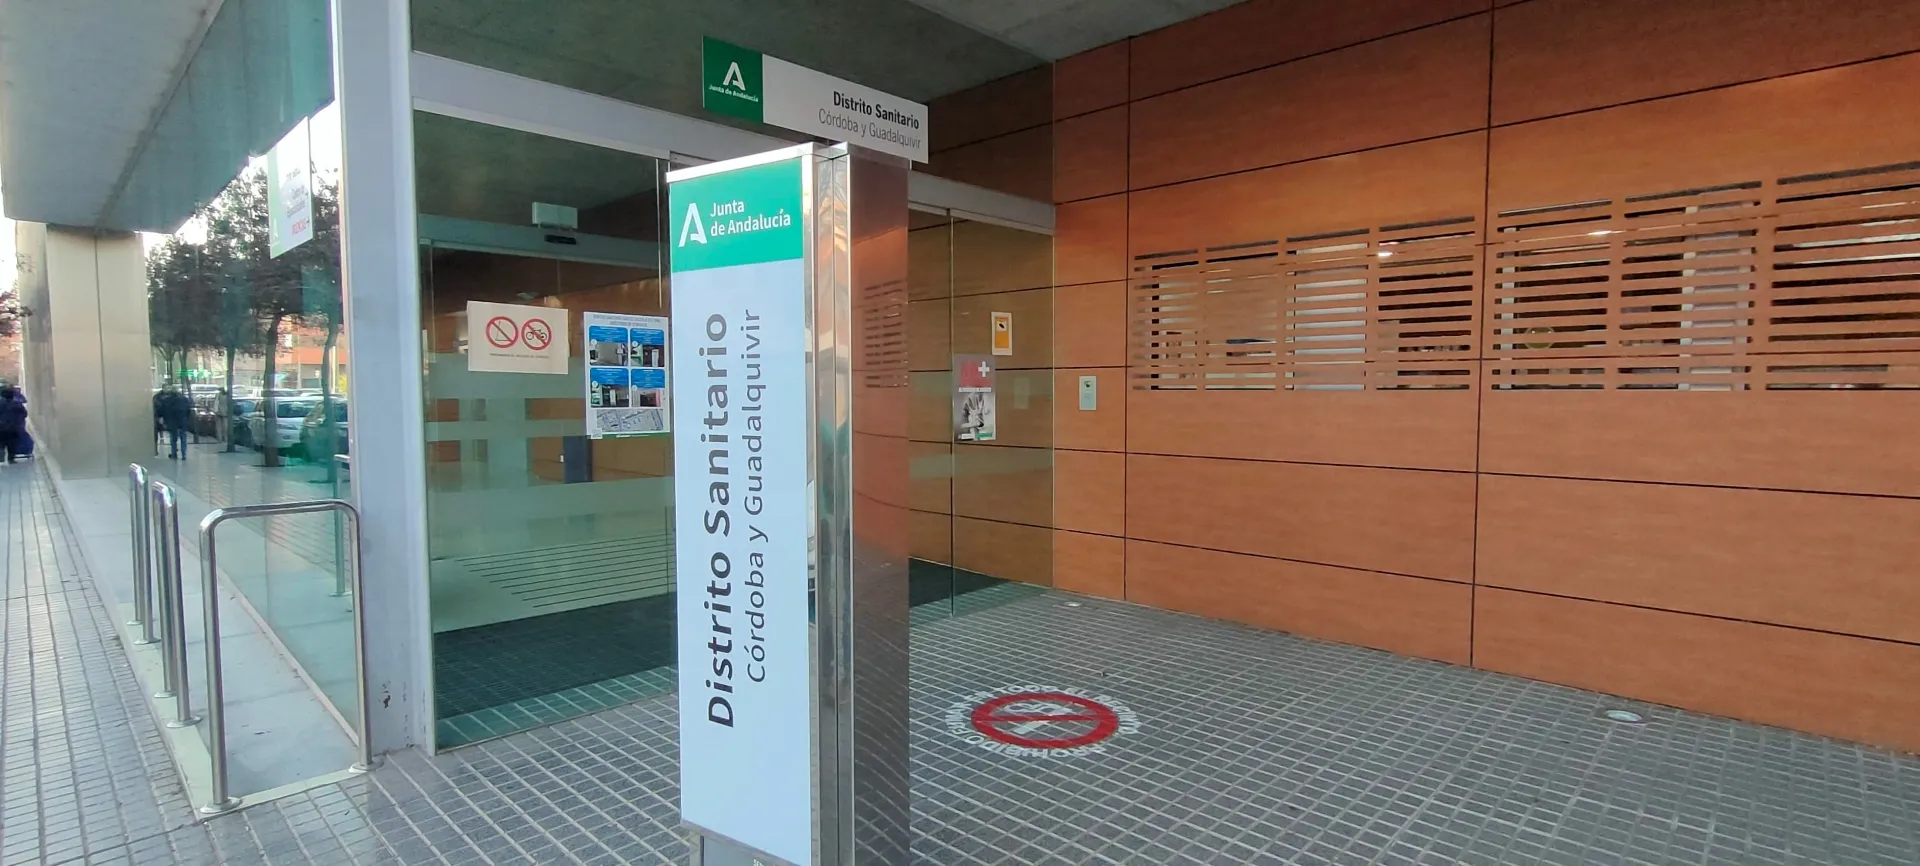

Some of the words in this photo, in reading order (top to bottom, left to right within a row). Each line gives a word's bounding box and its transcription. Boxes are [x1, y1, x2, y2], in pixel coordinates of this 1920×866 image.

[709, 84, 725, 93] Junta
[732, 90, 759, 102] Andalucía
[833, 90, 872, 115] Distrito
[875, 104, 919, 129] Sanitario
[818, 108, 859, 133] Córdoba
[861, 123, 867, 138] y
[869, 122, 921, 149] Guadalquivir
[710, 199, 745, 218] Junta
[710, 222, 725, 237] de
[727, 208, 791, 235] Andalucía
[698, 313, 731, 538] Sanitario
[740, 309, 767, 516] Guadalquivir
[749, 525, 769, 543] y
[744, 552, 766, 683] Córdoba
[704, 551, 734, 728] Distrito
[966, 735, 1107, 758] PROHIBIDO
